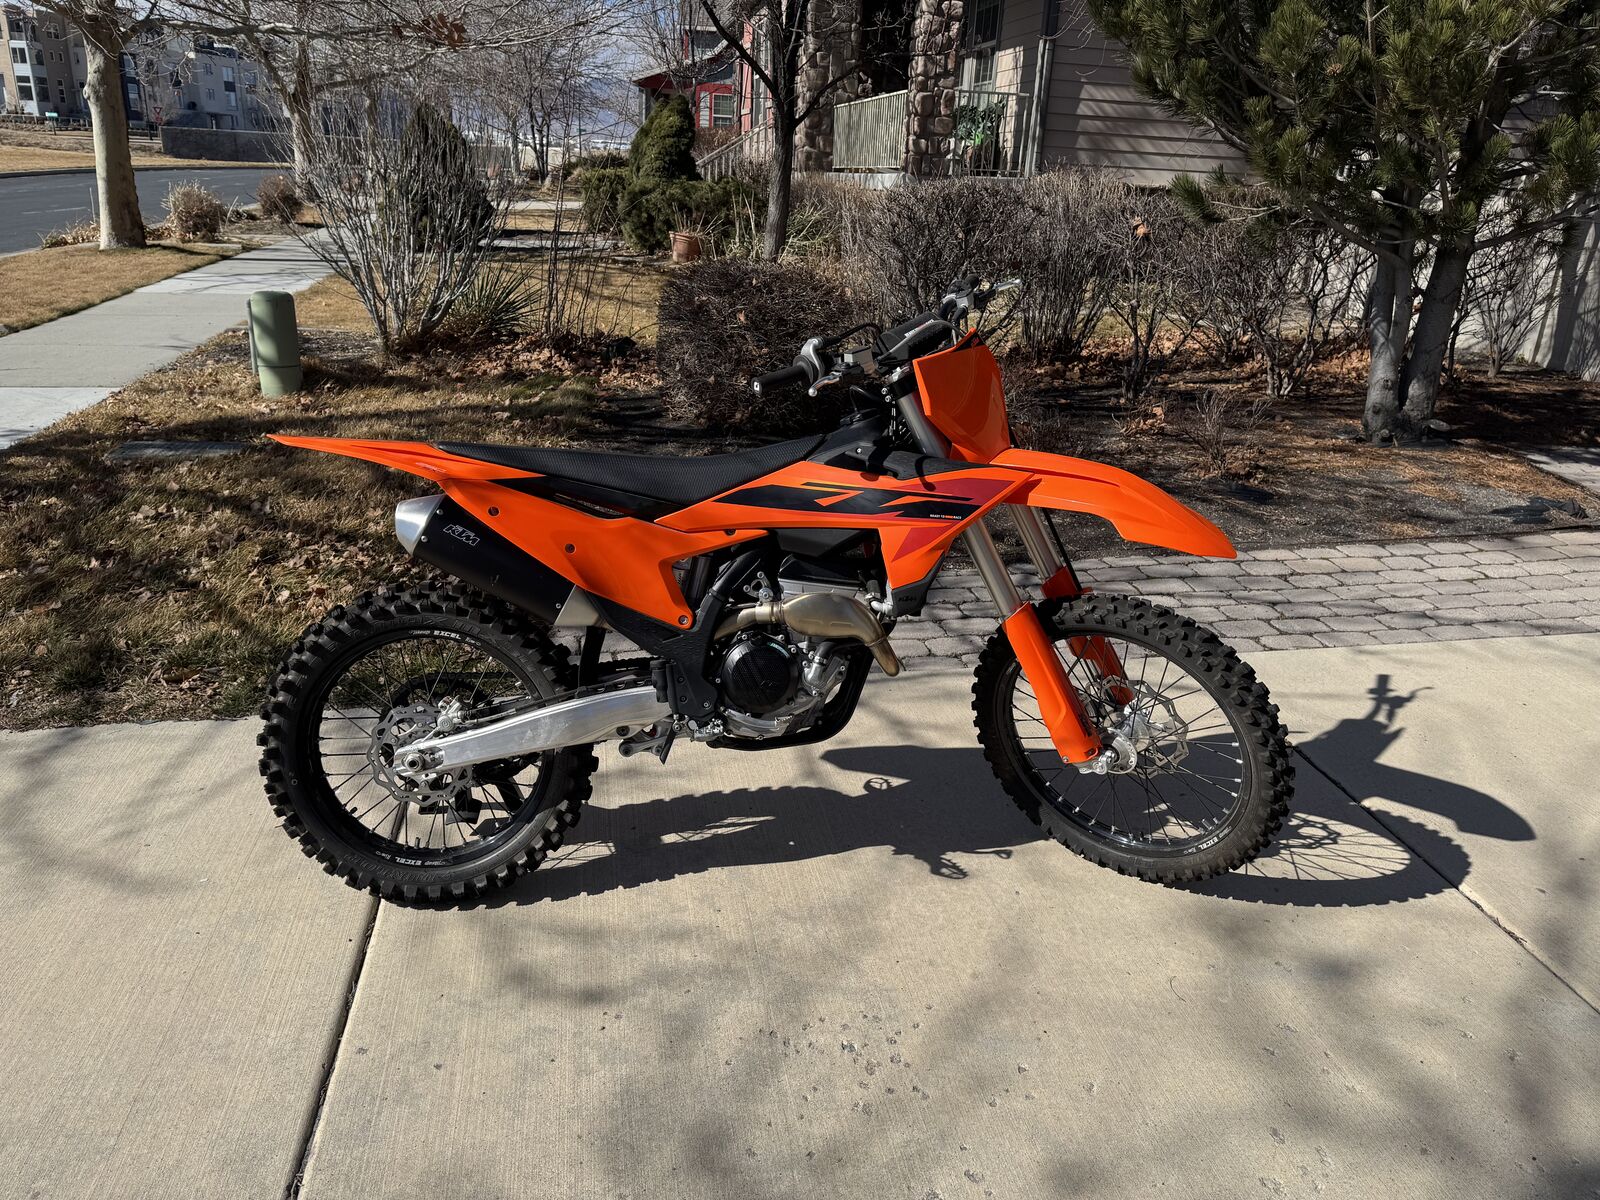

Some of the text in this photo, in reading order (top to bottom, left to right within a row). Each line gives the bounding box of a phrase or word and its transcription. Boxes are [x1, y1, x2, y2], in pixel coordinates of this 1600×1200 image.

[443, 524, 480, 546] KTM
[433, 630, 462, 640] EXCEL
[1198, 836, 1219, 850] EXCEL
[395, 856, 422, 866] EXCEL
